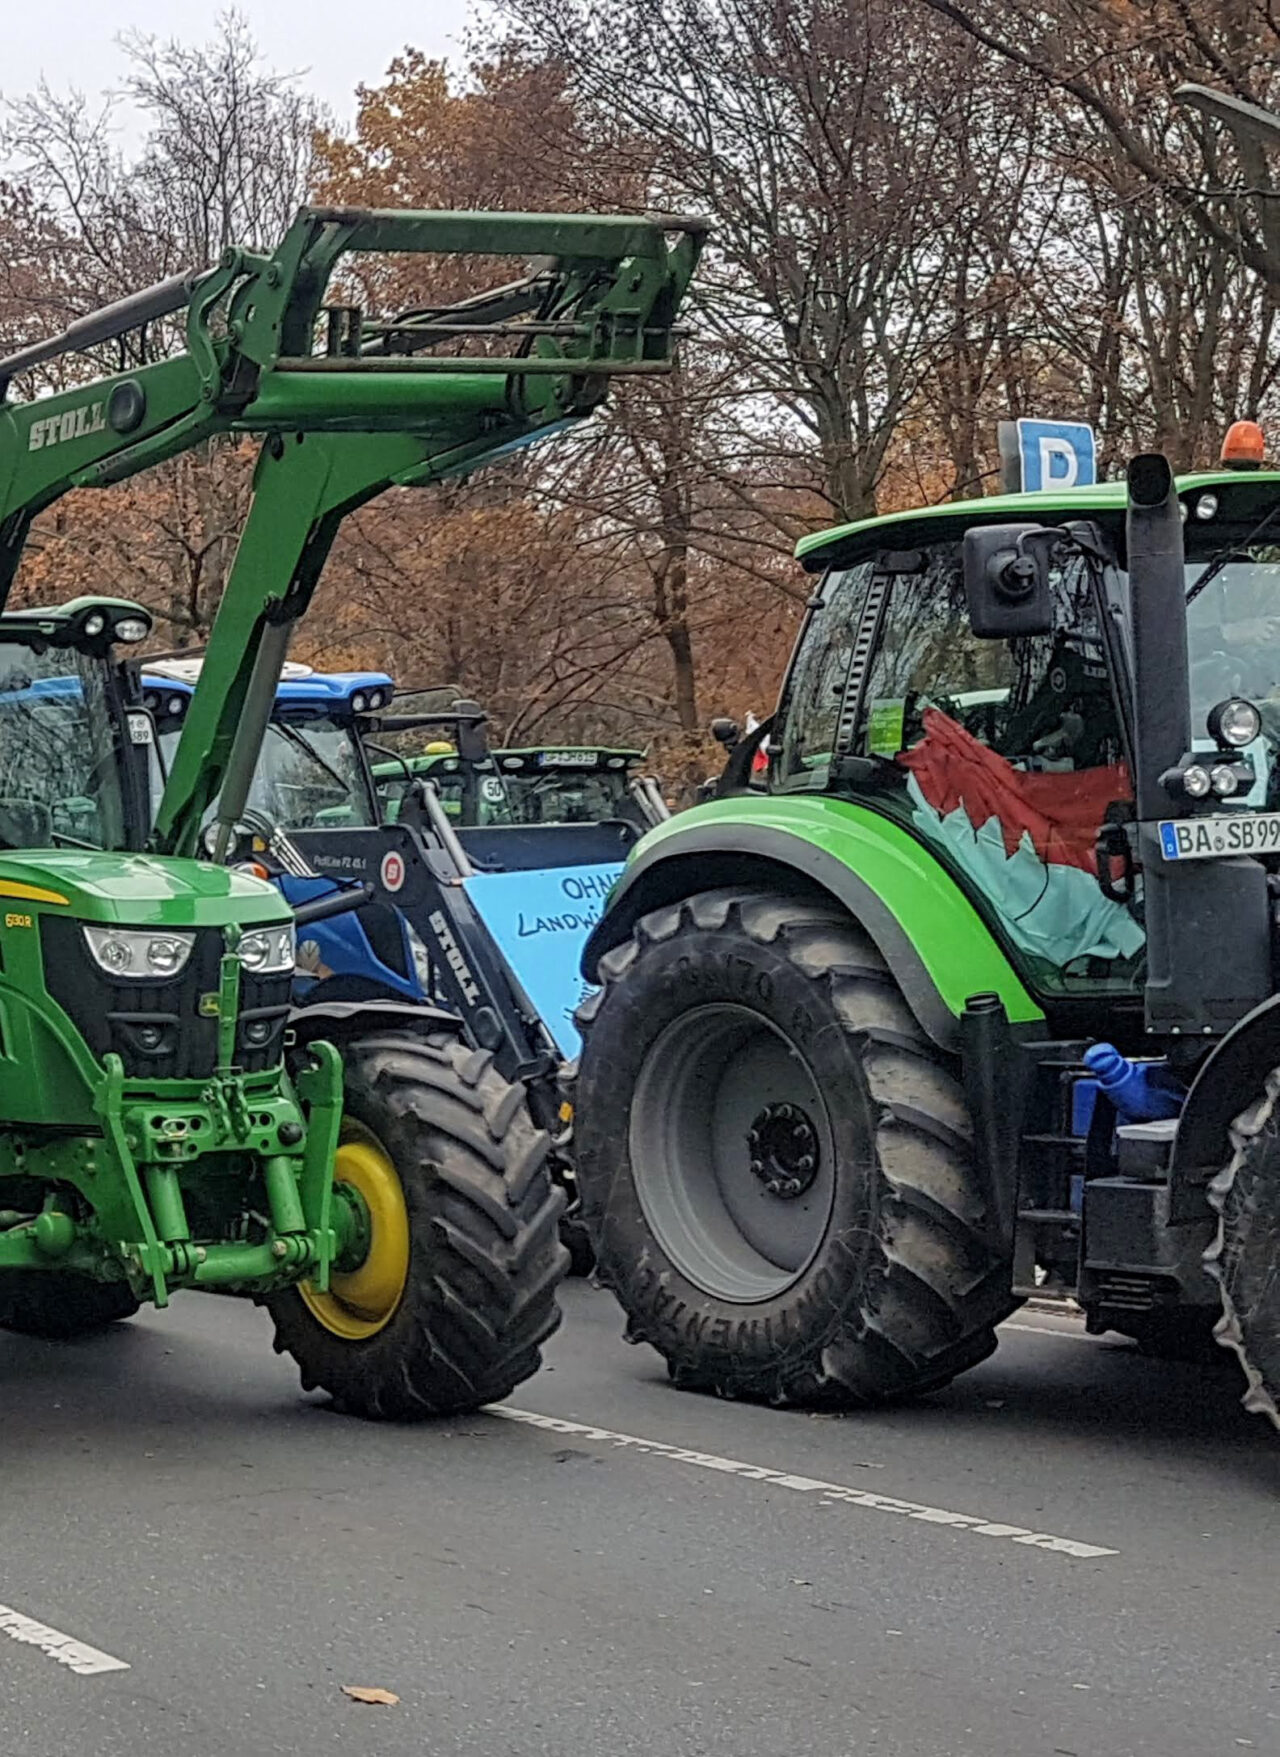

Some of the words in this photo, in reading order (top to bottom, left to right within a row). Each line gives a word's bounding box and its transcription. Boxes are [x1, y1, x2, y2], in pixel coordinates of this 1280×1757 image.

[29, 401, 106, 451] STOLL
[487, 781, 502, 797] 50
[1177, 825, 1212, 853] BA
[1227, 821, 1254, 849] SB
[1258, 819, 1280, 847] 99
[428, 910, 480, 1006] STOLL
